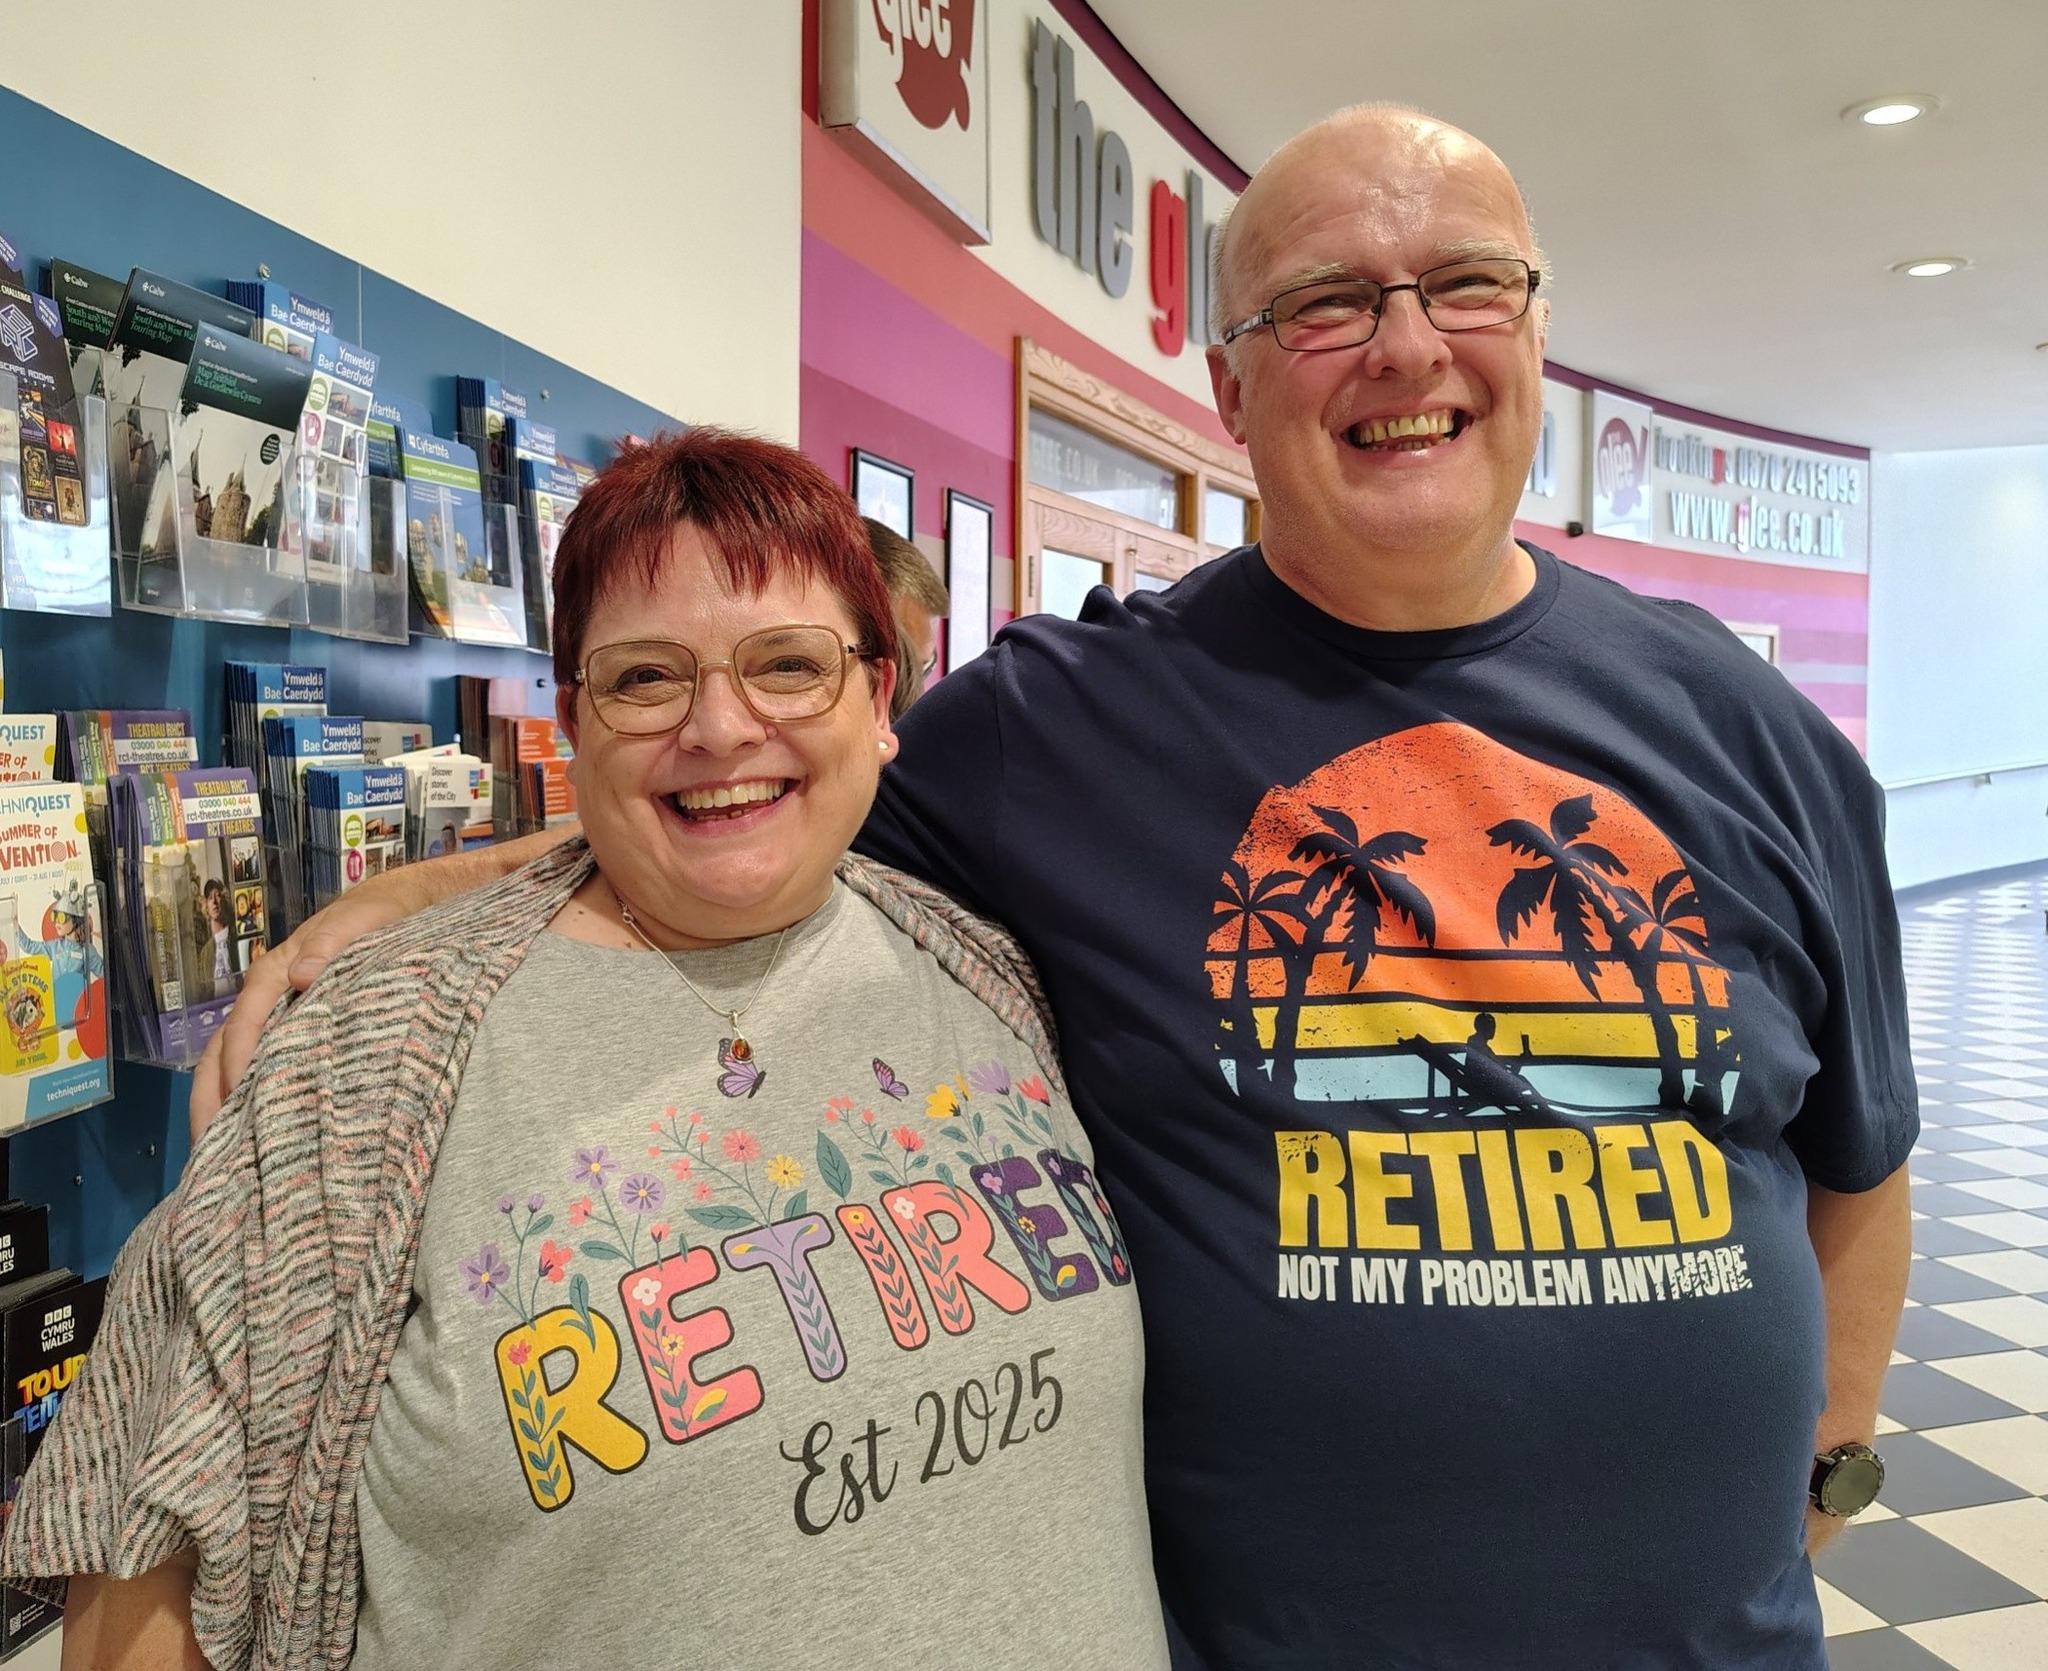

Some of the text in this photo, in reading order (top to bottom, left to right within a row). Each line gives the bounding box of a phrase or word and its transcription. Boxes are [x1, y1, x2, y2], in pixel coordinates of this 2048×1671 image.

[1030, 17, 1226, 357] the gl
[271, 304, 288, 321] Bae
[291, 297, 325, 322] Ymweld
[339, 346, 370, 371] Ymweld
[318, 354, 374, 388] Bae Caerdydd
[370, 401, 401, 422] yfarthfa
[416, 437, 450, 459] Cyfarthfa
[1600, 433, 1634, 499] glee
[1738, 448, 1781, 493] 0870
[1784, 456, 1859, 505] 2415093
[1670, 490, 1844, 559] www.glee.co.uk
[283, 672, 318, 685] Ymweld
[264, 686, 324, 702] Bae Caerdydd
[128, 723, 166, 738] THEATRAU
[322, 724, 356, 737] Ymweld
[131, 741, 155, 750] 03000
[173, 739, 187, 749] 444
[303, 739, 361, 754] Bae Caerdydd
[14, 755, 27, 769] OF
[118, 750, 189, 763] rct-theatres.co.uk
[432, 766, 453, 776] Discover
[193, 779, 249, 796] THEATRAU RHCT
[365, 775, 398, 788] Ymweld
[0, 794, 71, 818] HNIQUEST
[198, 796, 252, 809] 03000 040 444
[347, 788, 403, 804] Bae Caerdydd
[187, 806, 254, 821] rct-theatres.co.uk
[44, 826, 58, 839] OF
[206, 818, 255, 837] RCT THEATRES
[47, 1077, 101, 1102] techniquest.org
[1274, 1119, 1732, 1251] RETIRED
[1278, 1244, 1753, 1306] NOT MY PROBLEM ANYMORE
[41, 1316, 76, 1341] CYMRU
[494, 1148, 1131, 1512] RETIRED
[41, 1330, 74, 1352] WALES
[779, 1346, 1064, 1536] Est 2025
